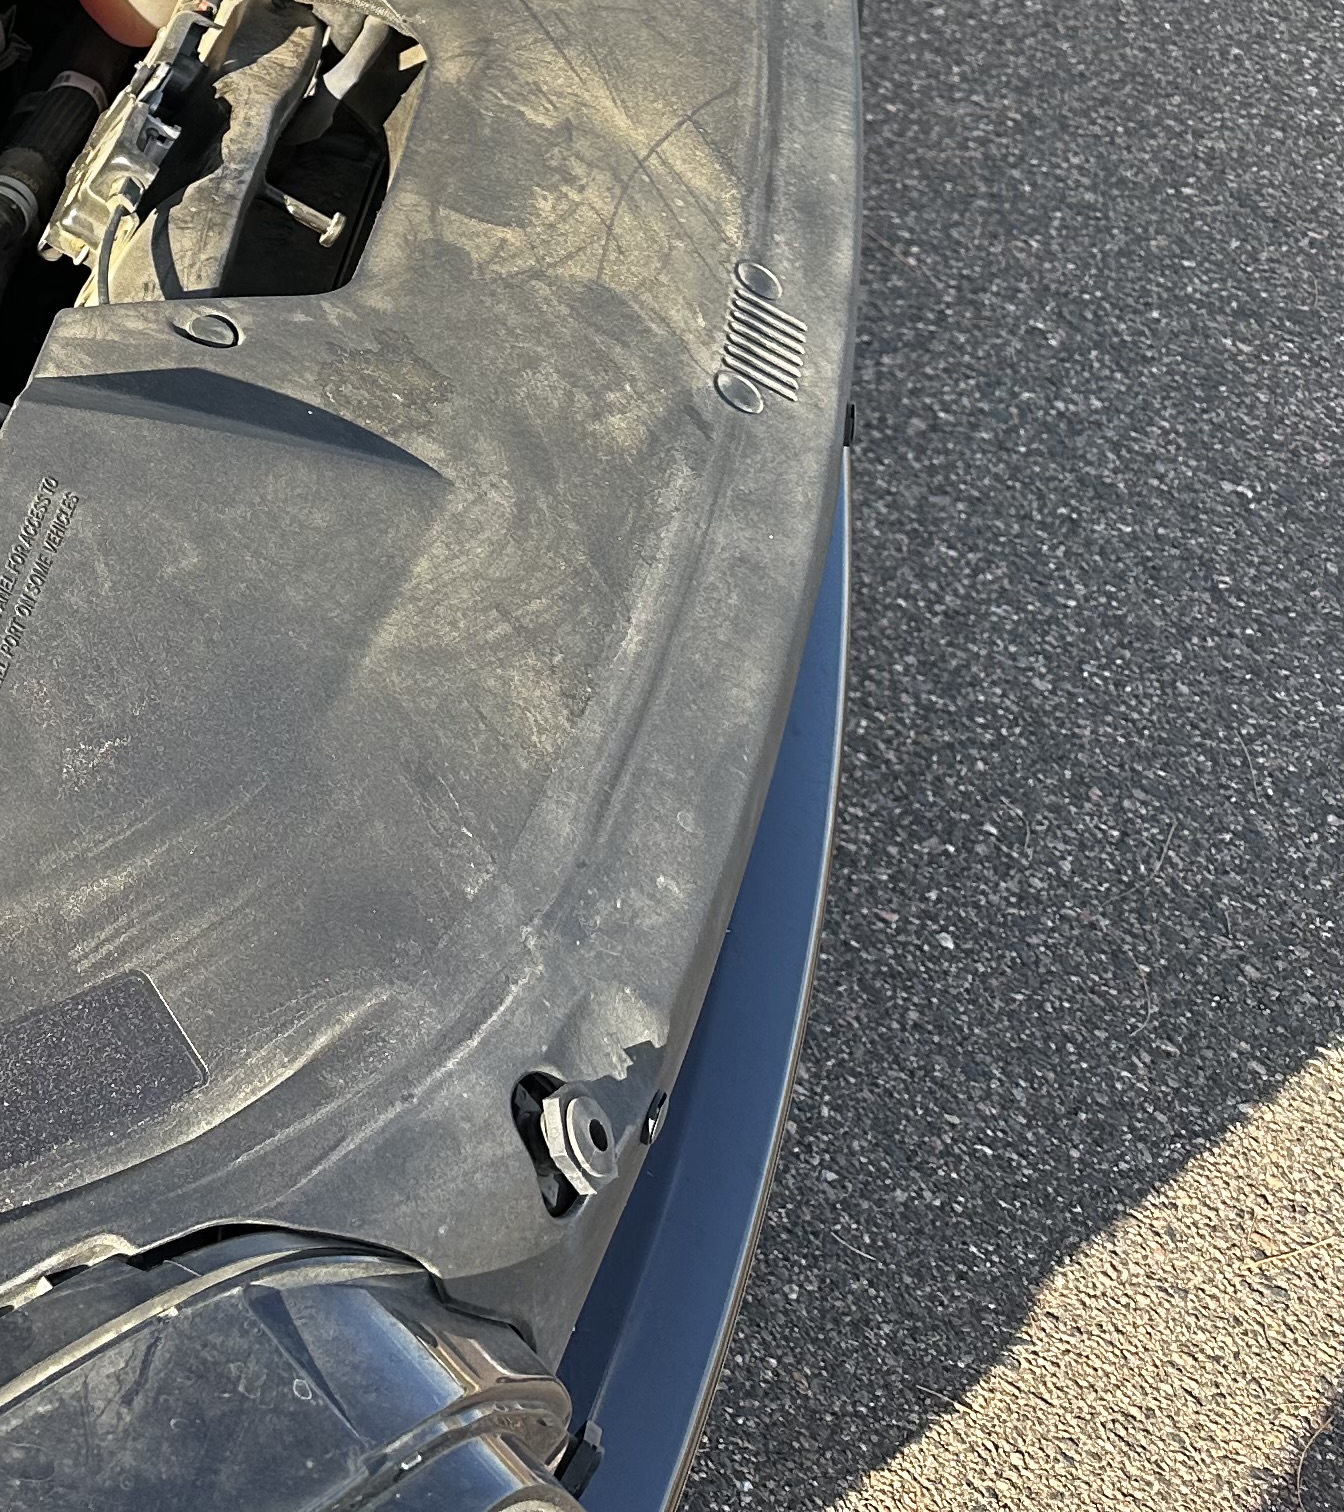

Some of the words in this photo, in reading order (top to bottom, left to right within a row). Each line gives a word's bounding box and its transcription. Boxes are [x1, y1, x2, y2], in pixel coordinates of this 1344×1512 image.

[5, 544, 31, 574] FOR
[18, 493, 51, 548] ACCESS
[39, 476, 58, 495] TO
[42, 491, 79, 553] VEHICLES
[24, 553, 53, 596] SOME
[14, 593, 37, 617] ON
